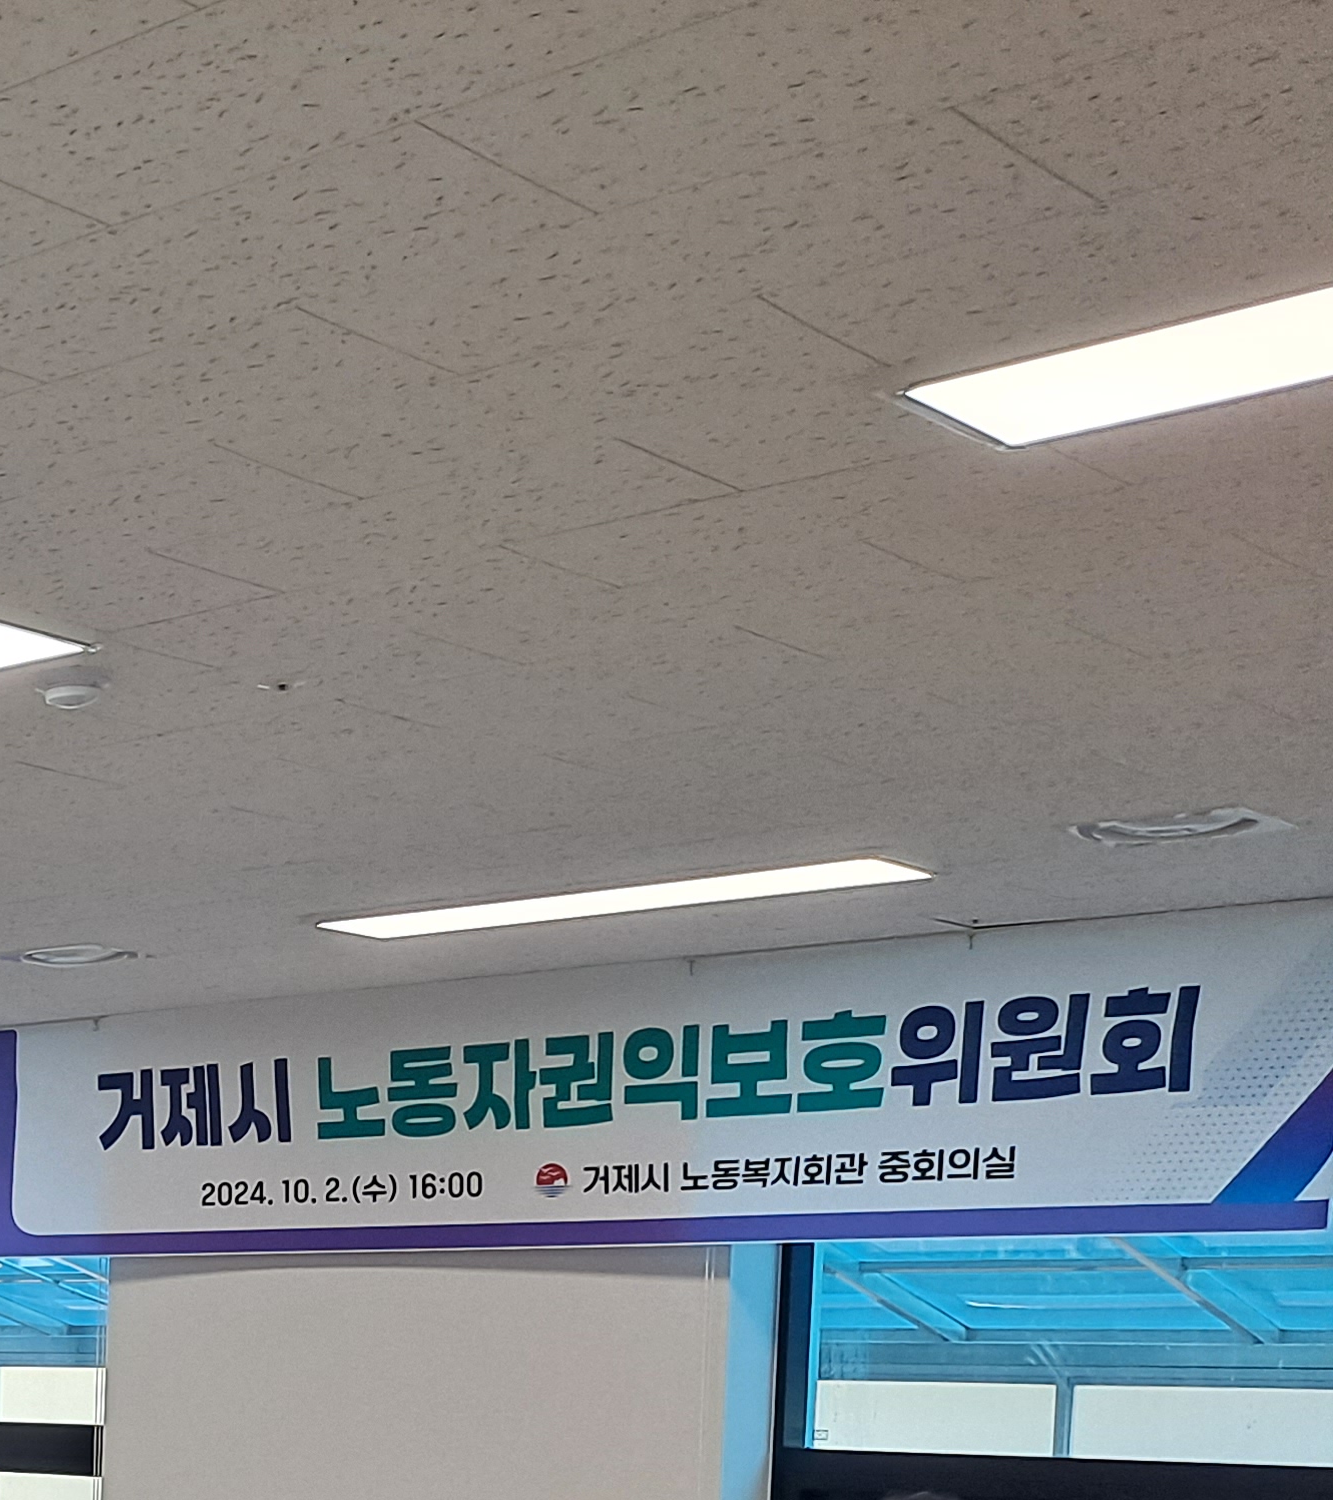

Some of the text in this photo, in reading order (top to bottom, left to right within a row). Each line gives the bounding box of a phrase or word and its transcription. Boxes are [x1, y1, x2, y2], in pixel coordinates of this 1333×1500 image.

[96, 985, 1201, 1152] 거제시 노동자권익보호위원회
[200, 1181, 275, 1208] 2024.
[281, 1179, 318, 1206] 10.
[408, 1171, 484, 1200] 16:00
[582, 1145, 1018, 1195] 거제시 노동복지회관 중회의실
